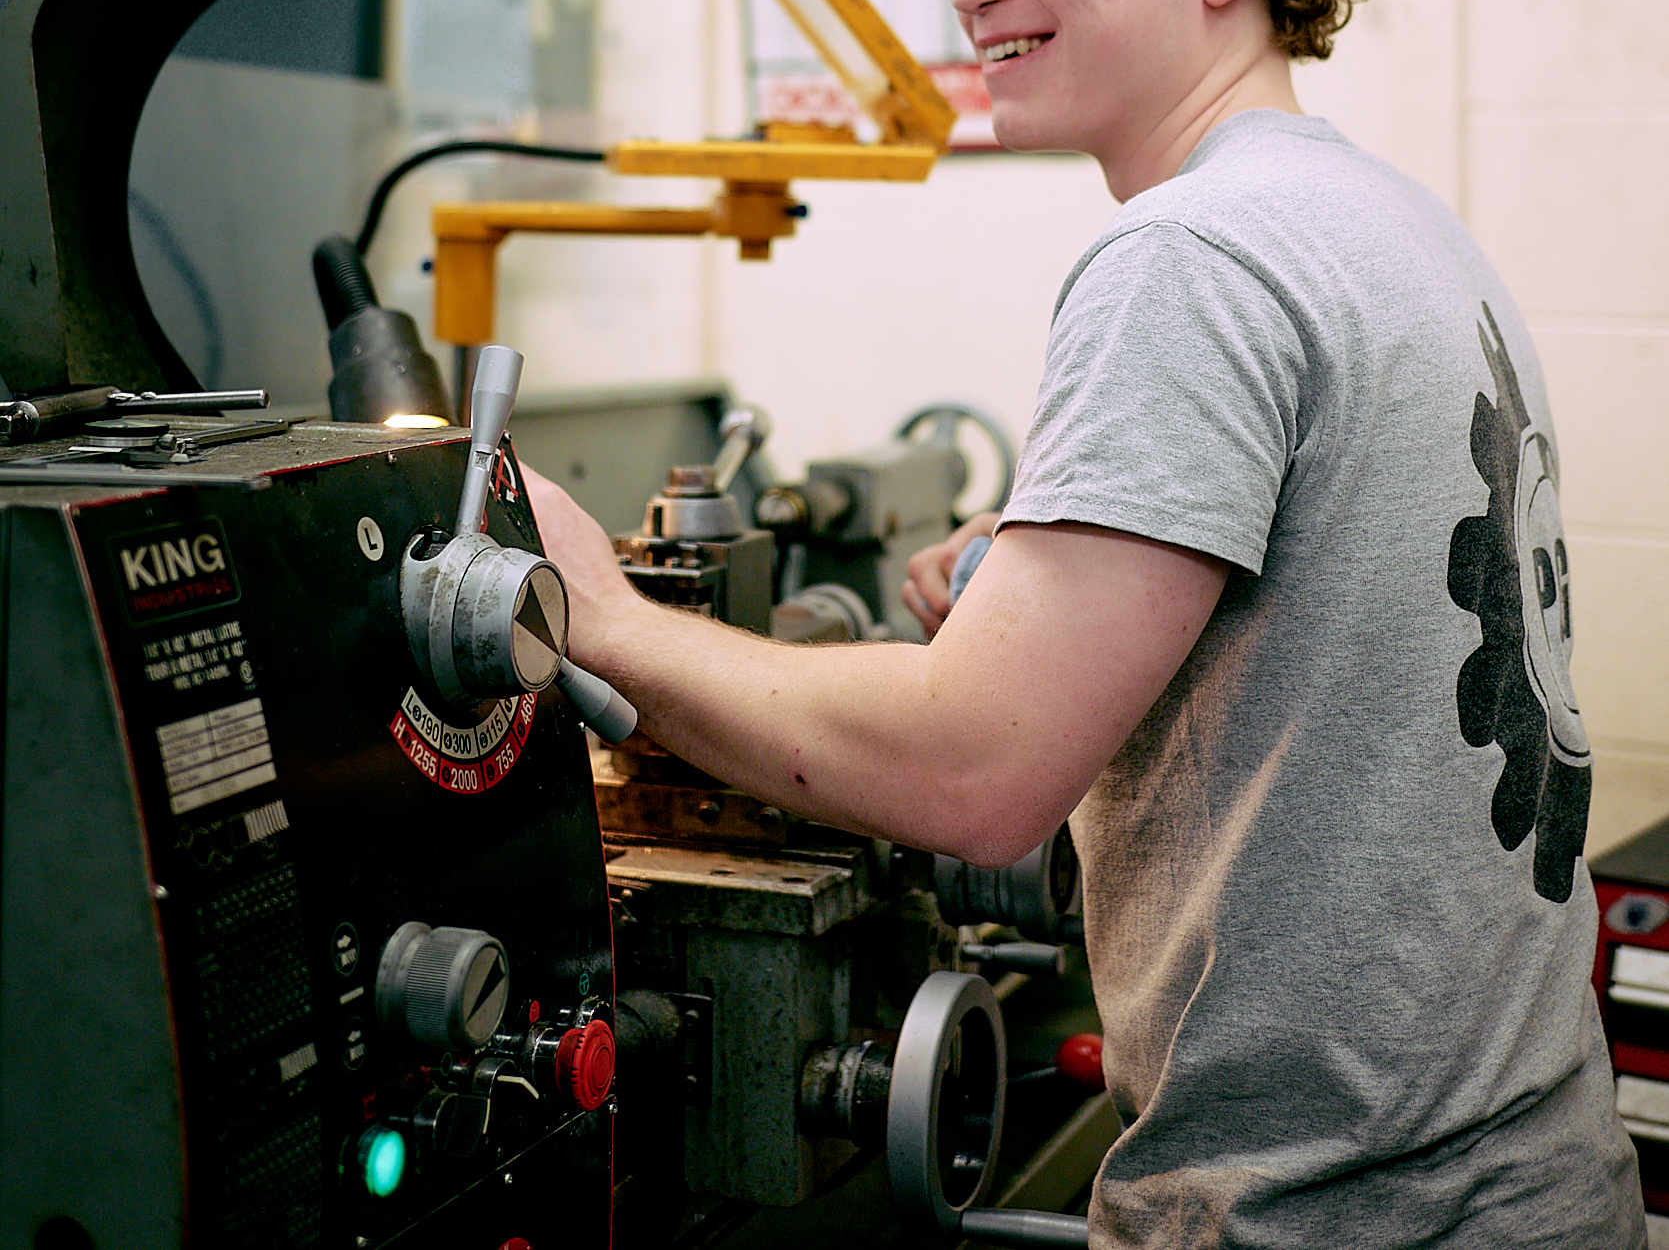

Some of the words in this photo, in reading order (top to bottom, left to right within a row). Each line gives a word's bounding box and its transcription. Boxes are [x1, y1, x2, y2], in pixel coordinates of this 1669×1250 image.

[120, 533, 226, 591] KING
[364, 527, 378, 551] L
[215, 620, 242, 642] LATHE
[405, 694, 414, 715] L
[421, 713, 440, 743] 190
[452, 732, 472, 754] 300
[486, 713, 504, 743] 115
[394, 717, 406, 739] H
[410, 739, 437, 778] 1255
[451, 767, 478, 791] 2000
[495, 743, 515, 775] 755
